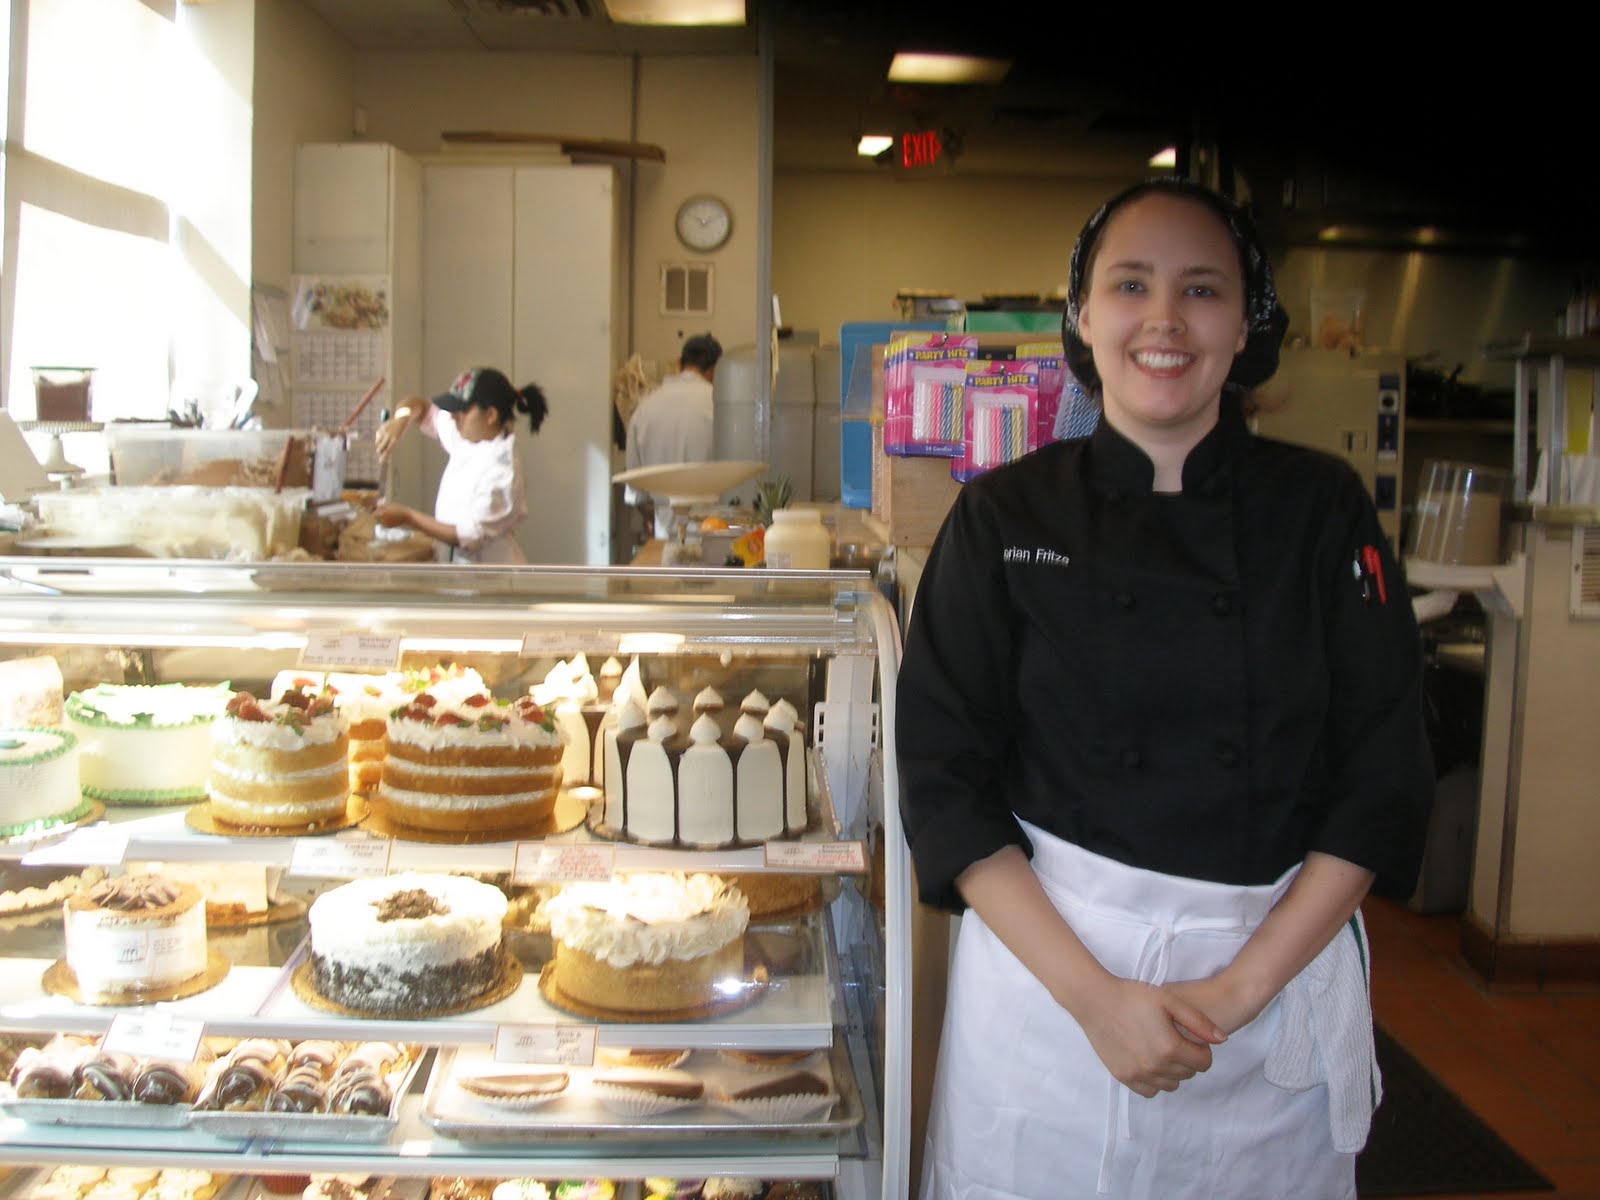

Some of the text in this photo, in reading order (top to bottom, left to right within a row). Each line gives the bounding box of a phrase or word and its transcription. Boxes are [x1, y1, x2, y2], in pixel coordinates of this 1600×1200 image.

[902, 132, 935, 168] EXIT
[915, 348, 968, 360] PARTY HITS
[975, 373, 1029, 386] PARTY HITS
